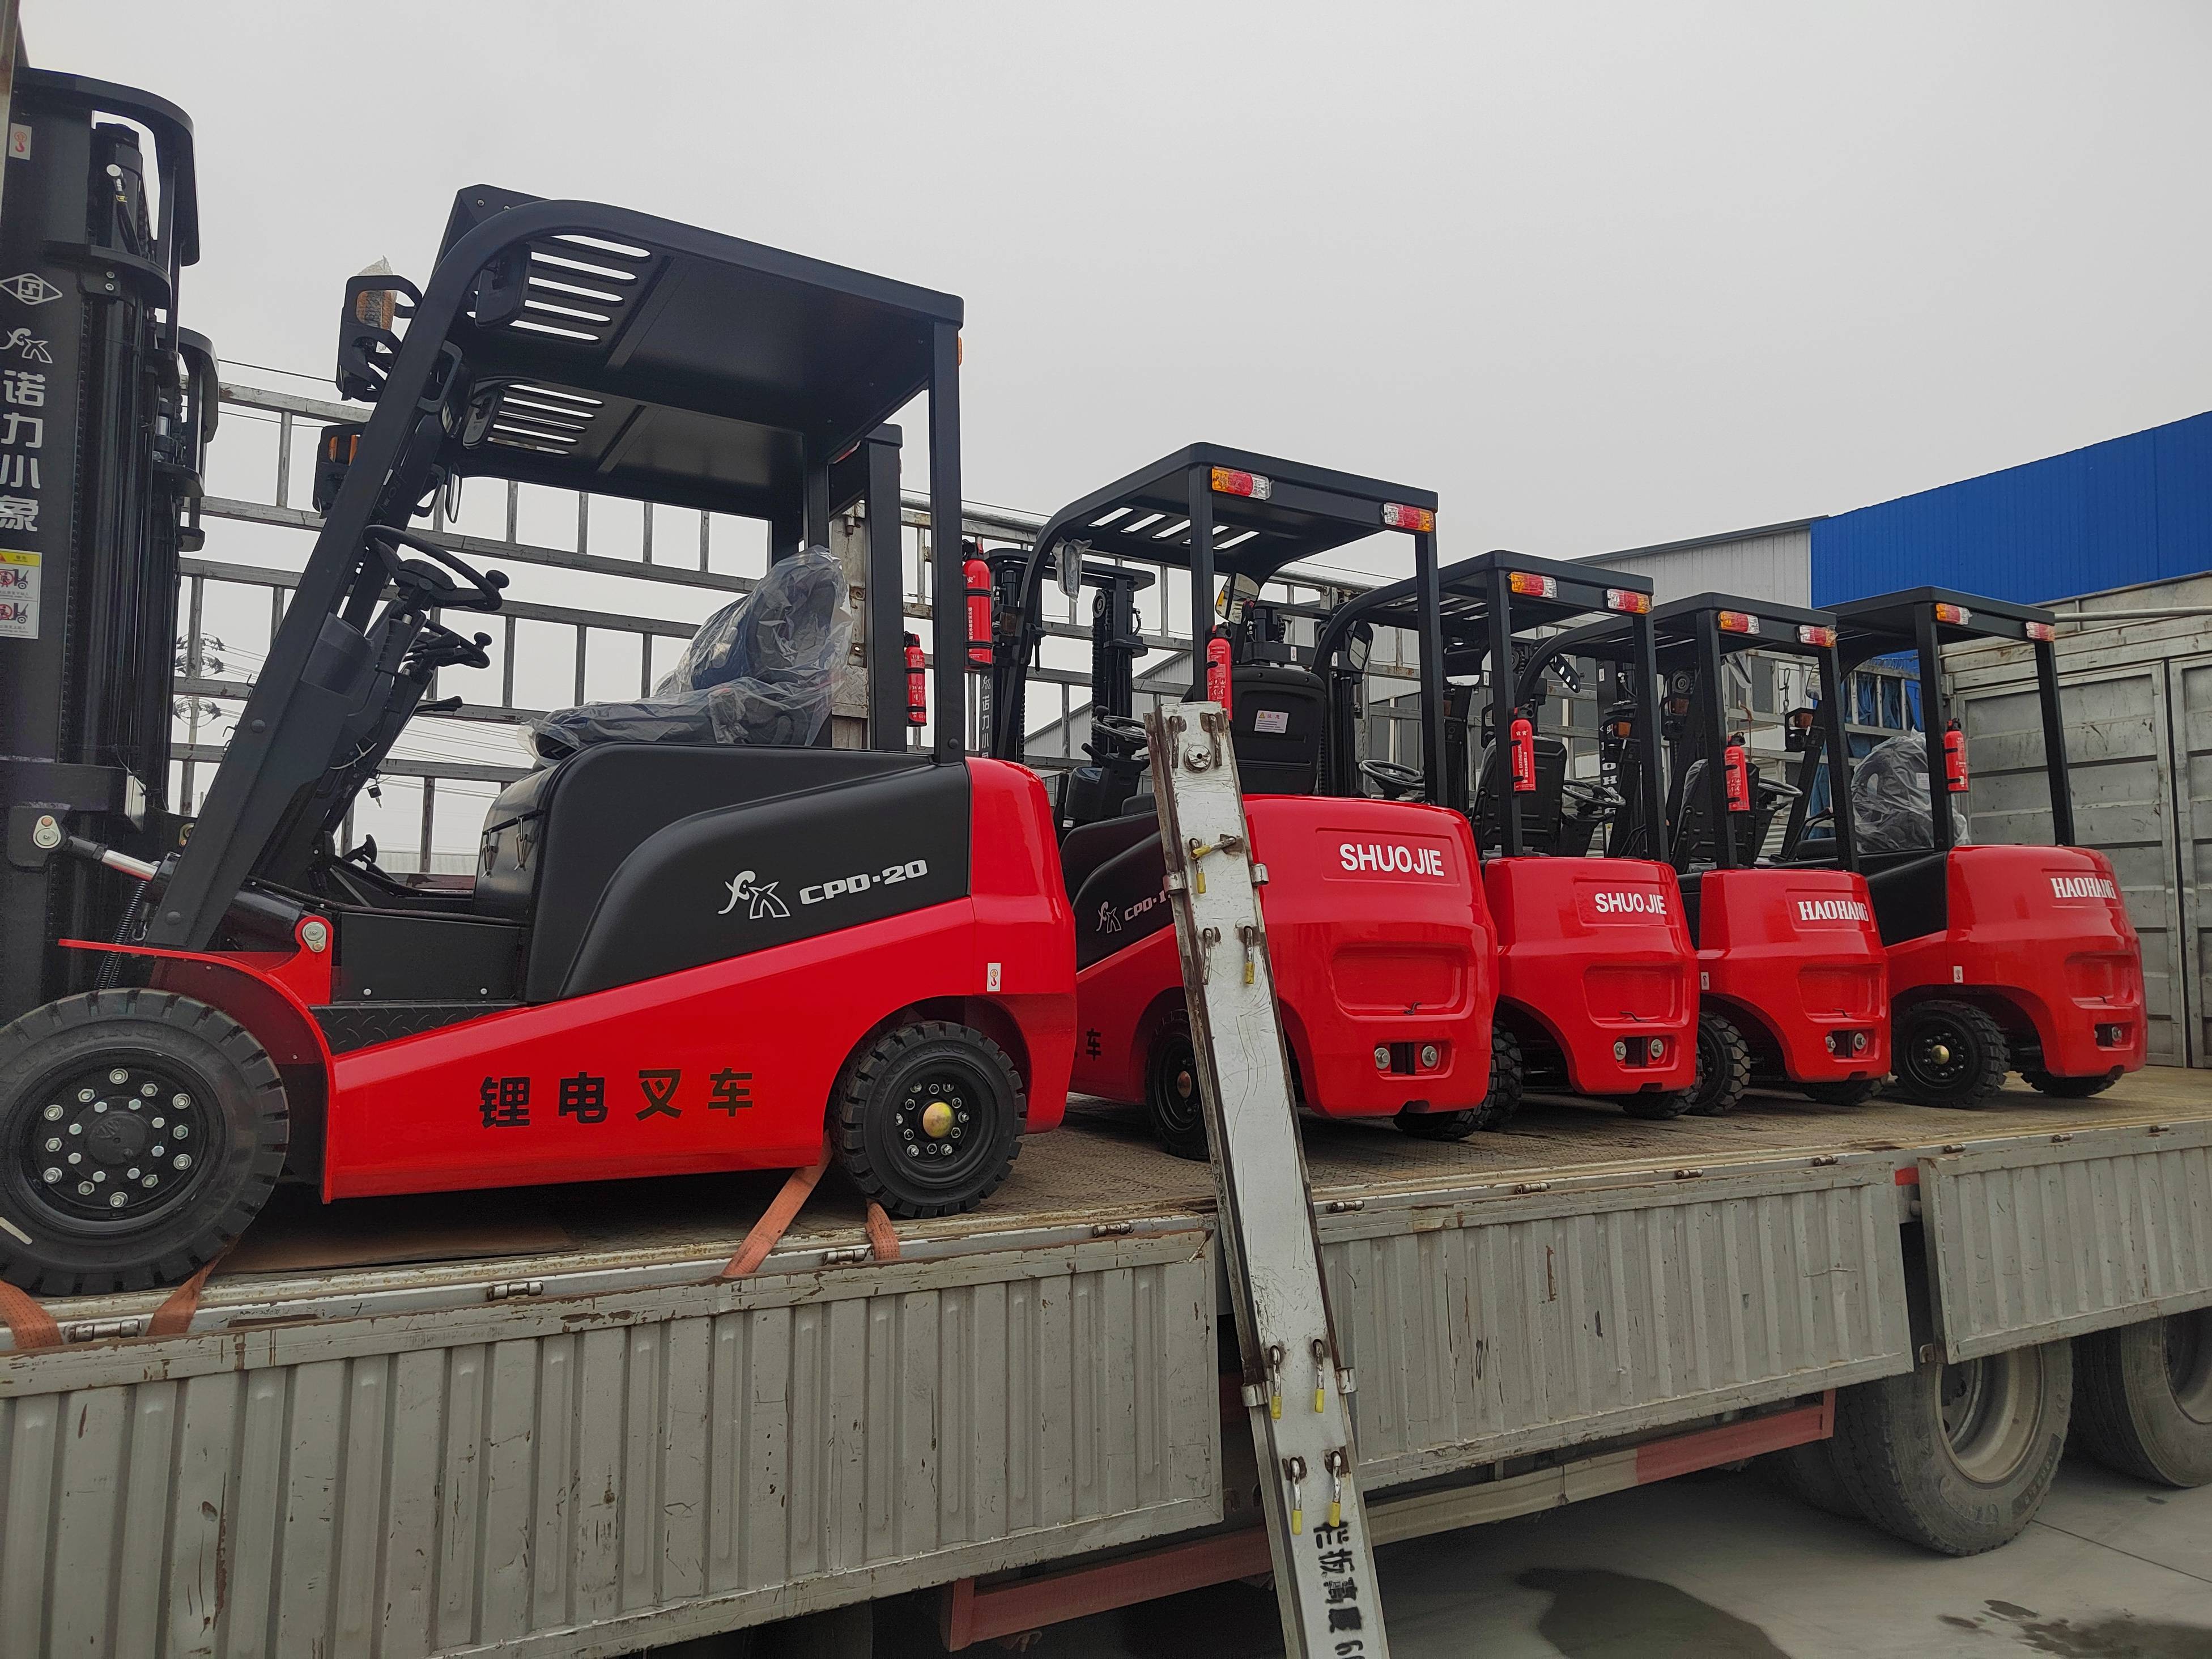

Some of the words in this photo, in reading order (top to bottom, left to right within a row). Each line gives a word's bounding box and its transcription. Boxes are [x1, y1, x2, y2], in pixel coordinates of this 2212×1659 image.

[1, 369, 45, 531] 诺力小象
[1339, 844, 1444, 877] SHUOJIE
[2050, 877, 2117, 899] HAOHANG
[1797, 900, 1869, 922] HAOHANG
[479, 1068, 753, 1128] 锂电叉车
